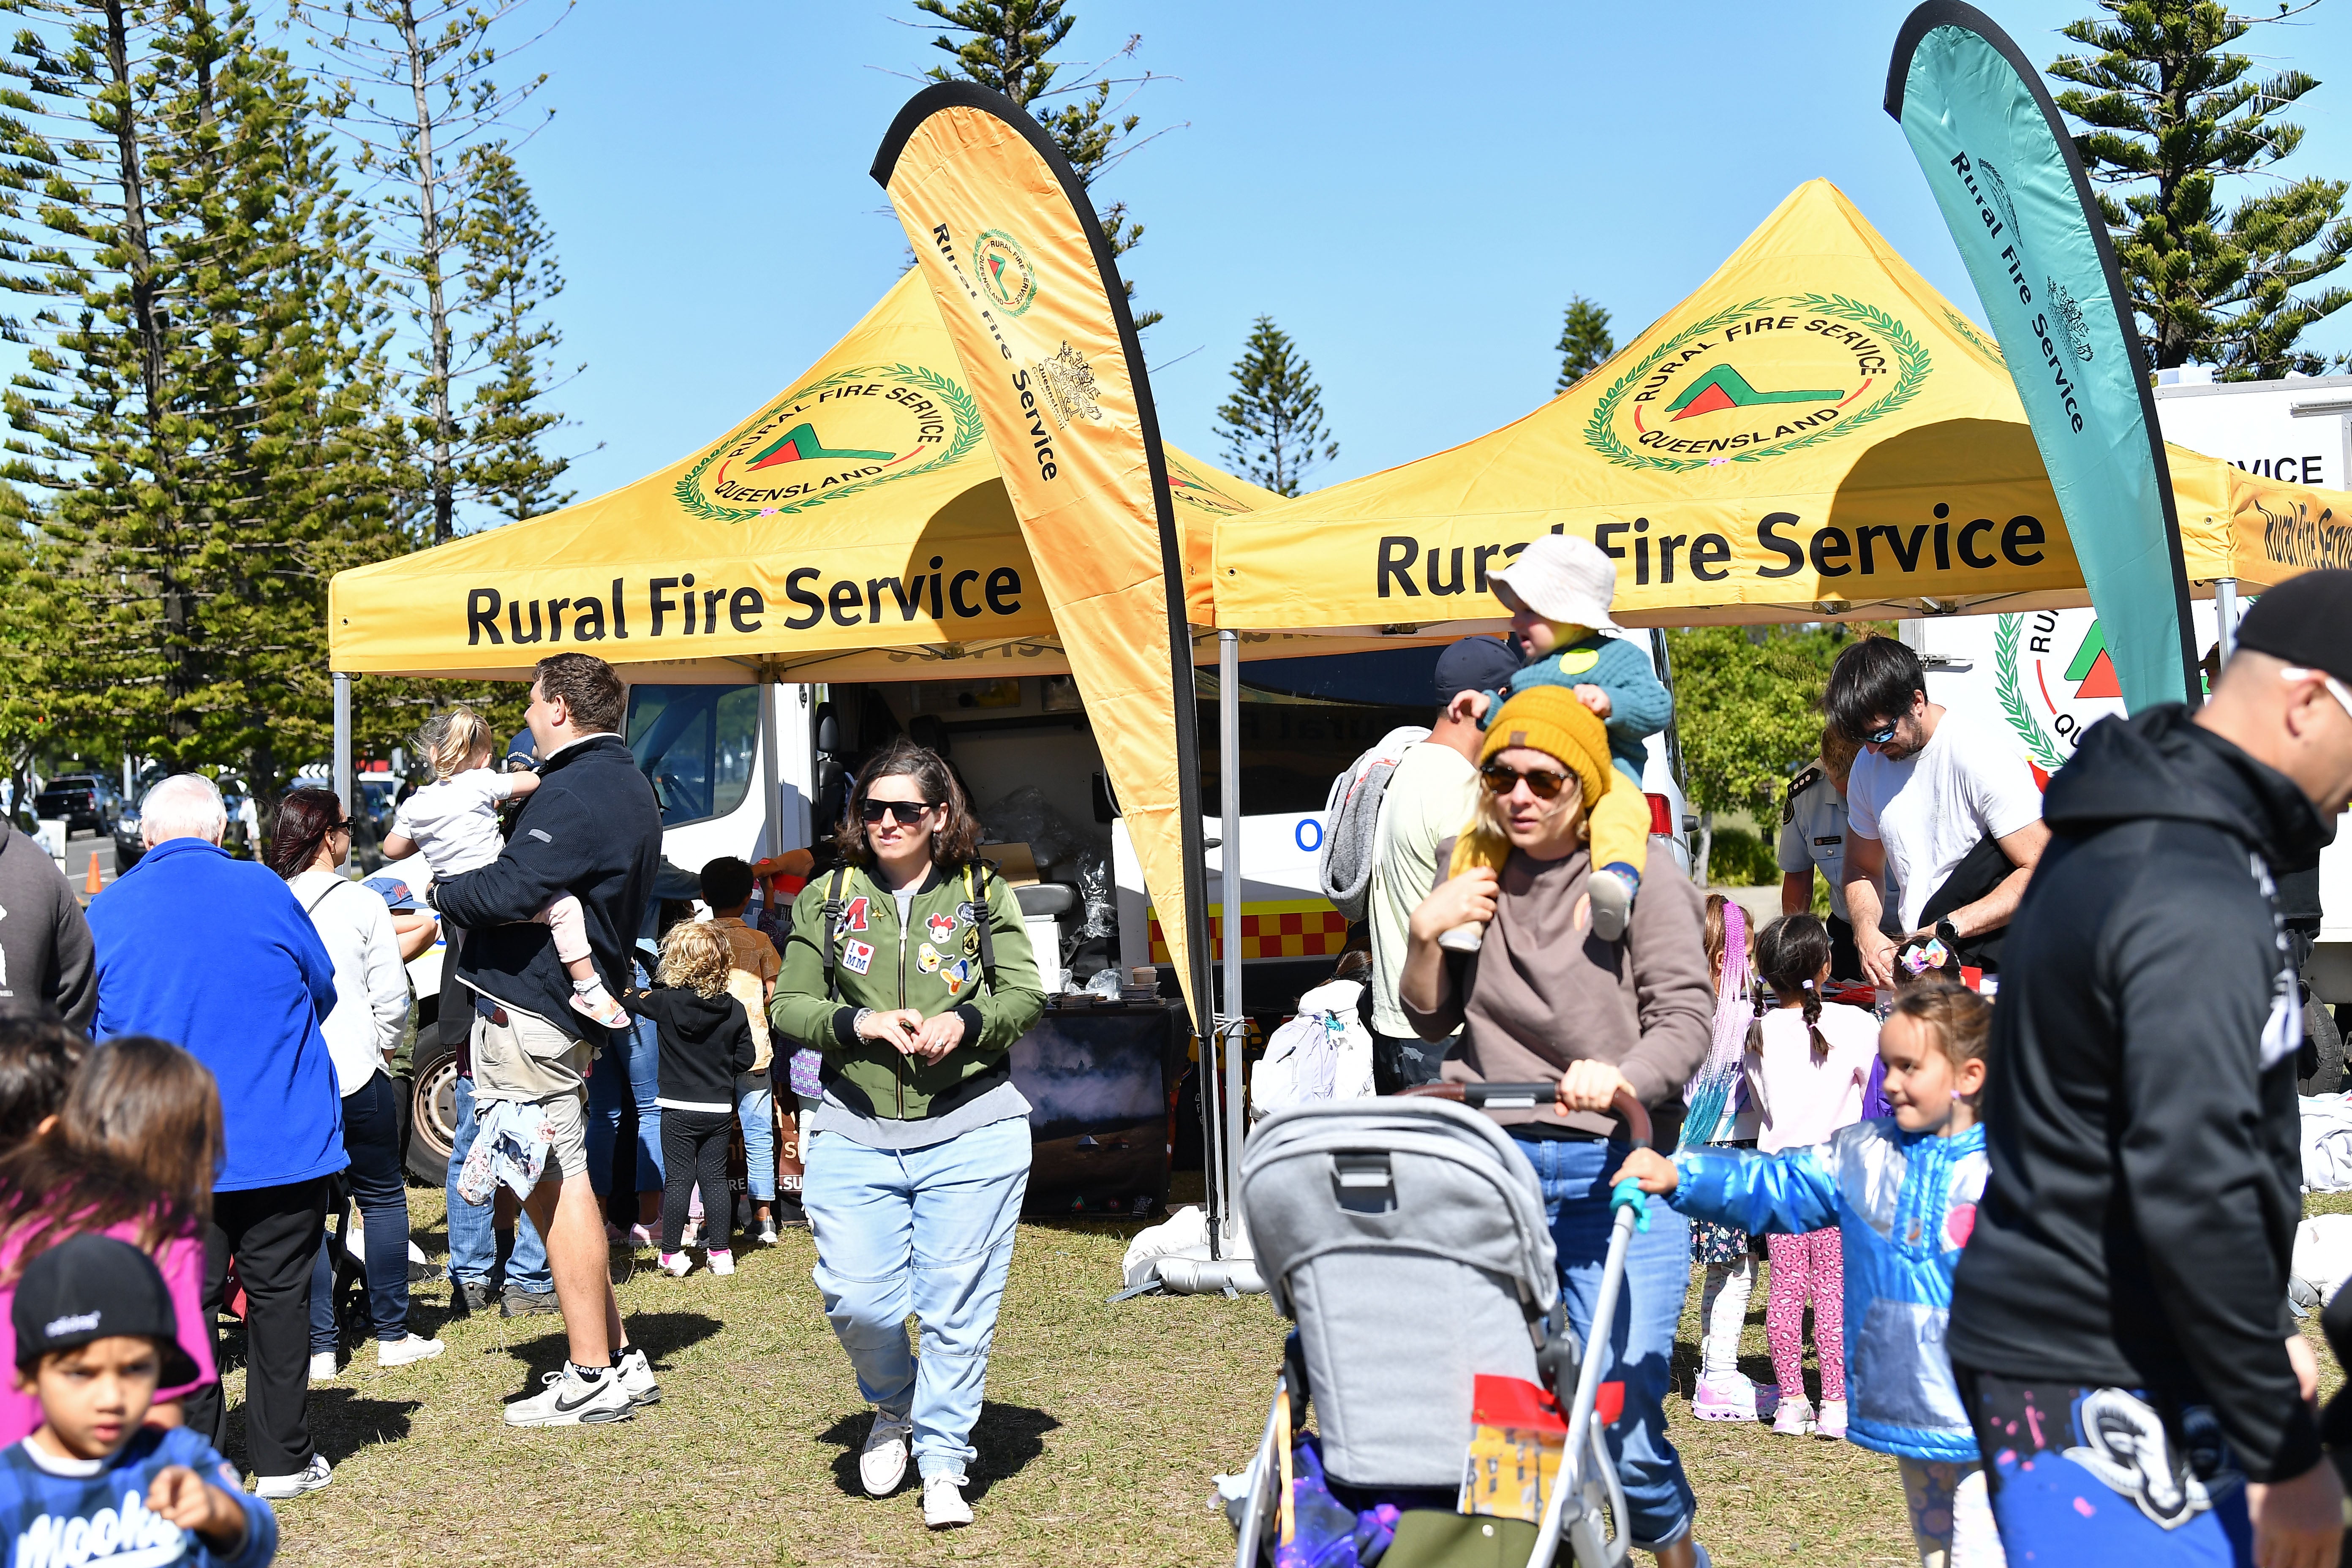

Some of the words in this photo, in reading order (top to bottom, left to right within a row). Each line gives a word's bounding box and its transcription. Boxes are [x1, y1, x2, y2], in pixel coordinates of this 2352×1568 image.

[990, 240, 1012, 253] RURAL
[1013, 251, 1025, 270] FIRE
[979, 255, 1004, 305] QUEENSLAND
[1015, 272, 1029, 305] SERVICE
[1950, 150, 2004, 240] Rural
[2001, 244, 2032, 306] Fire
[2031, 313, 2084, 435] Service
[1634, 342, 1719, 402] RURAL
[1725, 316, 1799, 343] FIRE
[1804, 319, 1886, 376] SERVICE
[727, 404, 811, 458] RURAL
[819, 384, 885, 403] FIRE
[885, 387, 944, 444] SERVICE
[1012, 369, 1057, 482] Service
[1638, 408, 1840, 453] QUEENSLAND
[714, 466, 883, 503] QUEENSLAND
[2228, 456, 2323, 484] VICE
[1377, 523, 1564, 598] Rur
[1595, 517, 1731, 585] Fire
[1755, 502, 2046, 578] Service
[2254, 499, 2298, 566] Rural
[2298, 501, 2319, 569] Fire
[467, 577, 629, 645] Rural
[650, 573, 762, 637] Fire
[784, 555, 1022, 630] Service
[846, 954, 867, 970] MM
[849, 942, 855, 953] I
